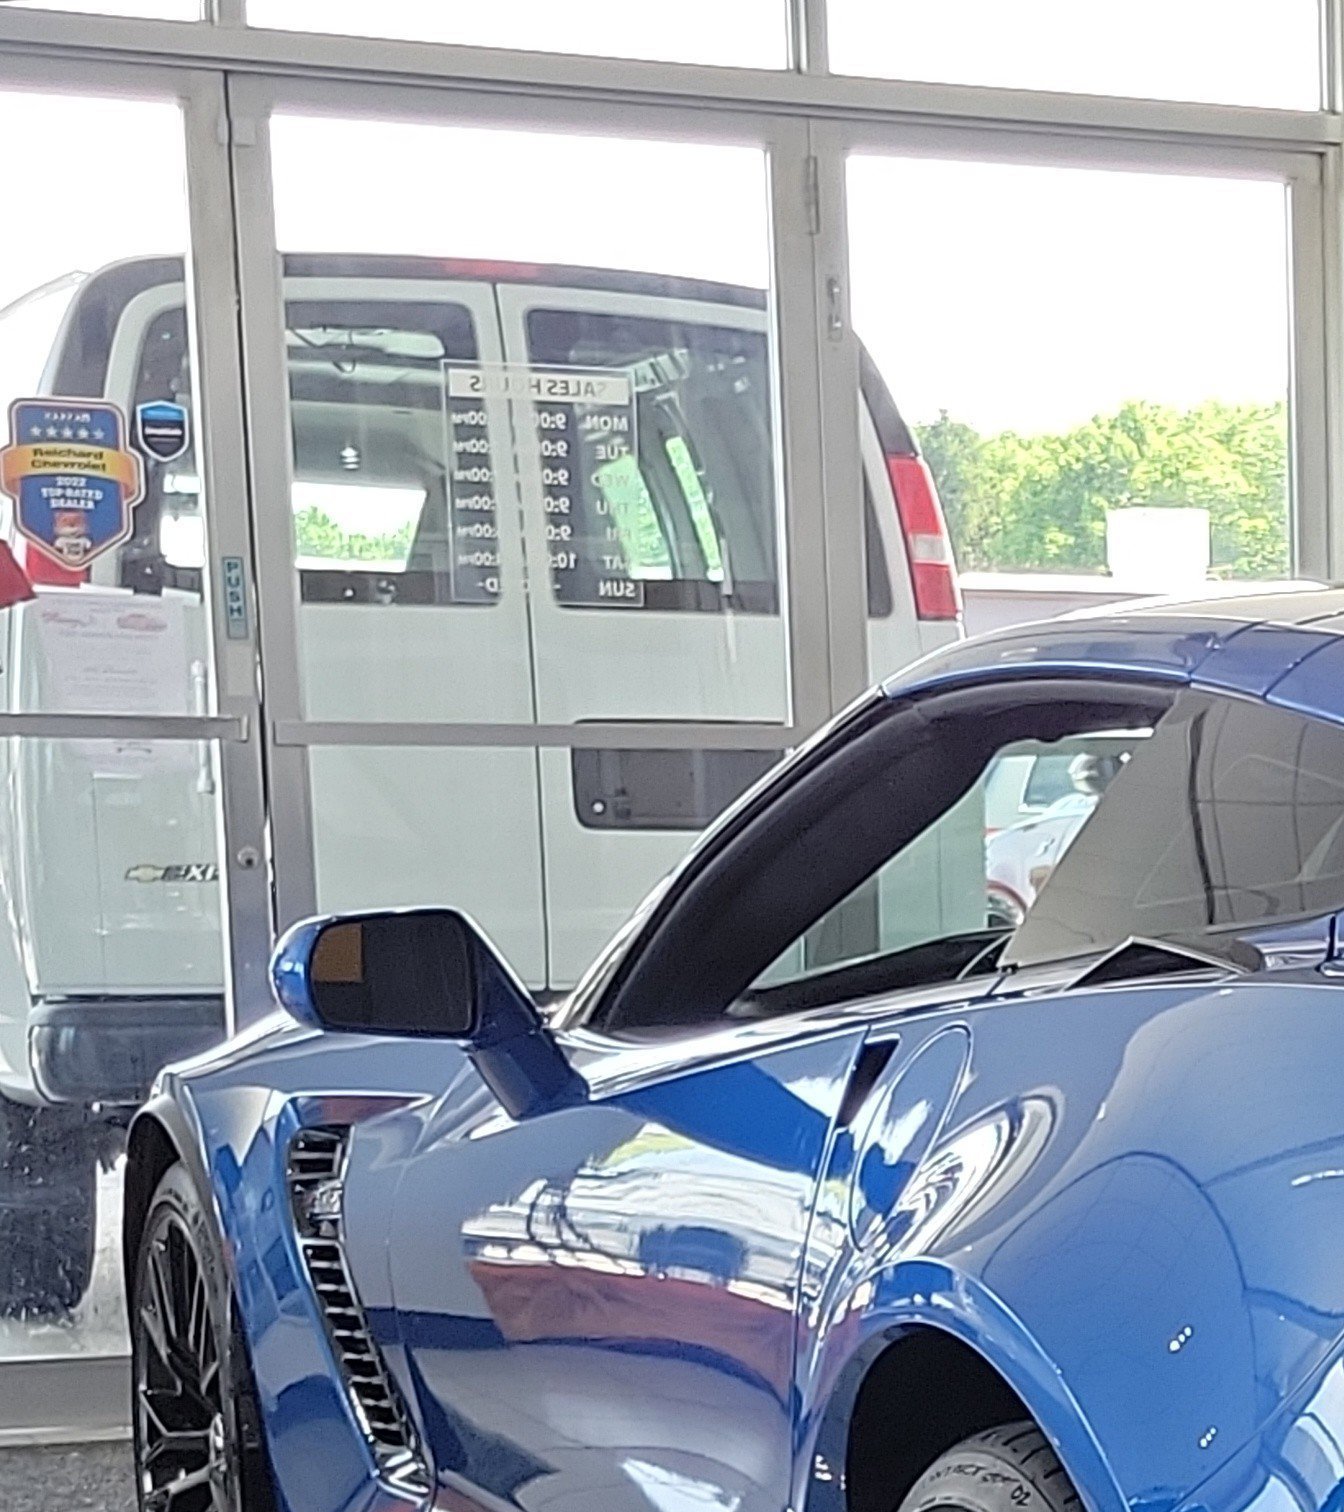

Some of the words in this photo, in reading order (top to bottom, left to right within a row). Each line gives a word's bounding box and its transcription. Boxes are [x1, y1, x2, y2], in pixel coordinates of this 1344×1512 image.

[32, 448, 104, 460] Reichard
[30, 459, 106, 473] Chevrolet
[227, 561, 243, 617] PUSH
